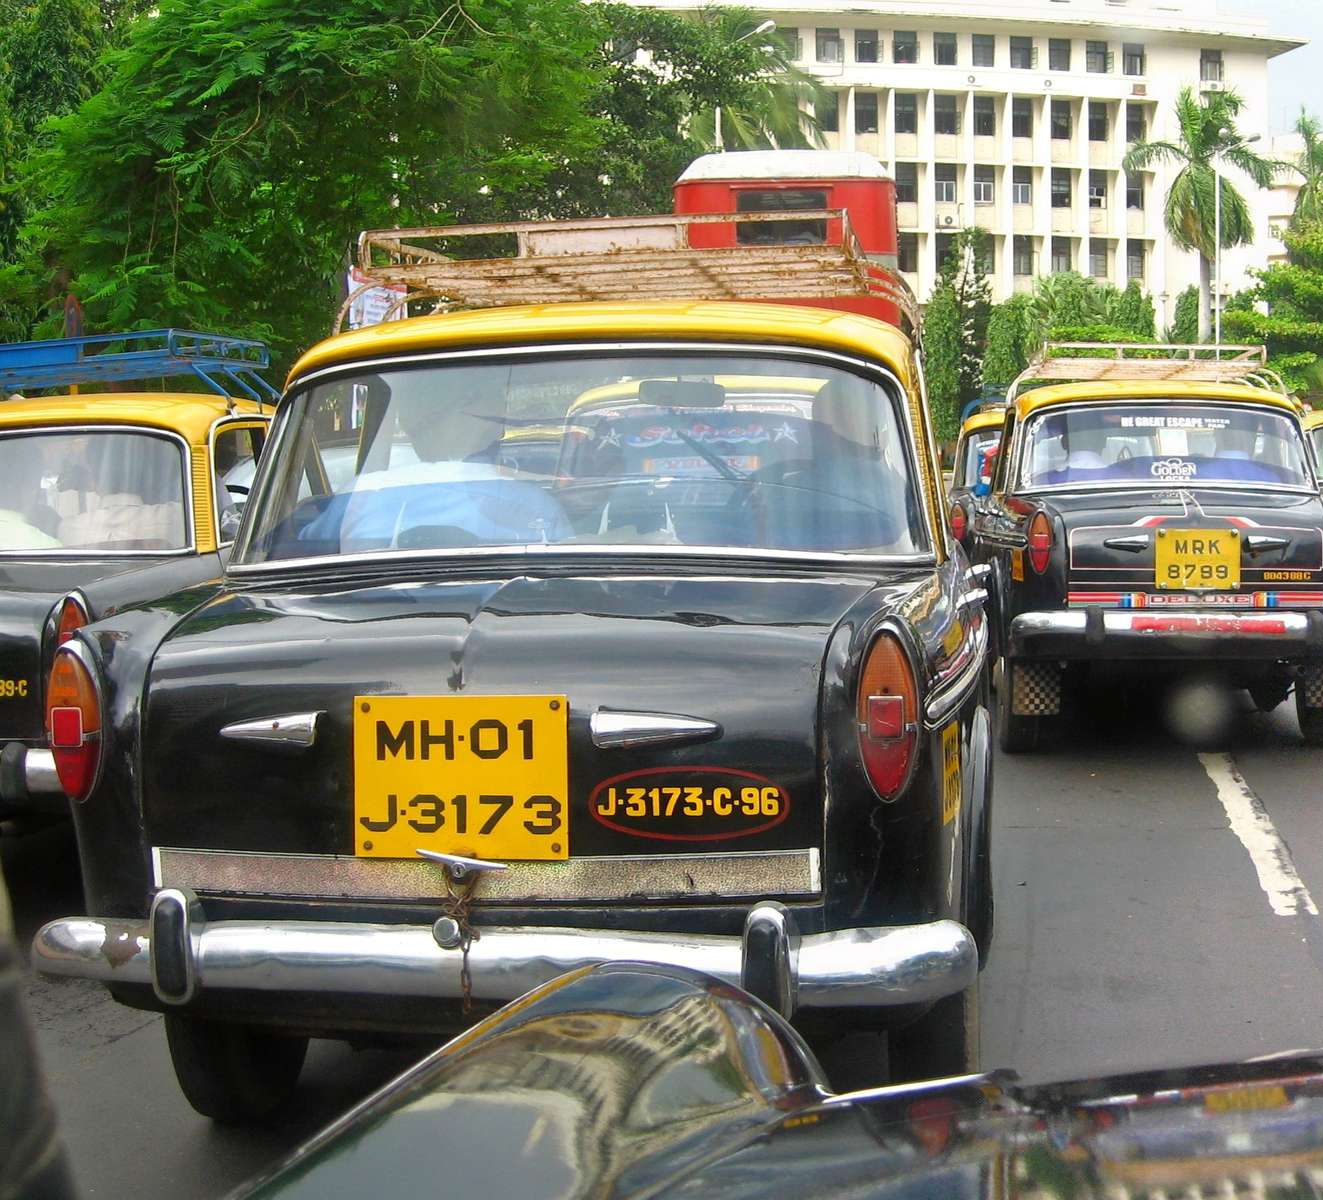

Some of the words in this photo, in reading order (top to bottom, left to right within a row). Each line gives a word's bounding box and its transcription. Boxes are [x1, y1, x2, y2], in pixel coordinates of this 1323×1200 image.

[1135, 417, 1165, 427] GREAT
[1167, 417, 1203, 428] ESCAPE
[1151, 461, 1197, 476] GOLDEN
[1150, 595, 1250, 604] DELUXE
